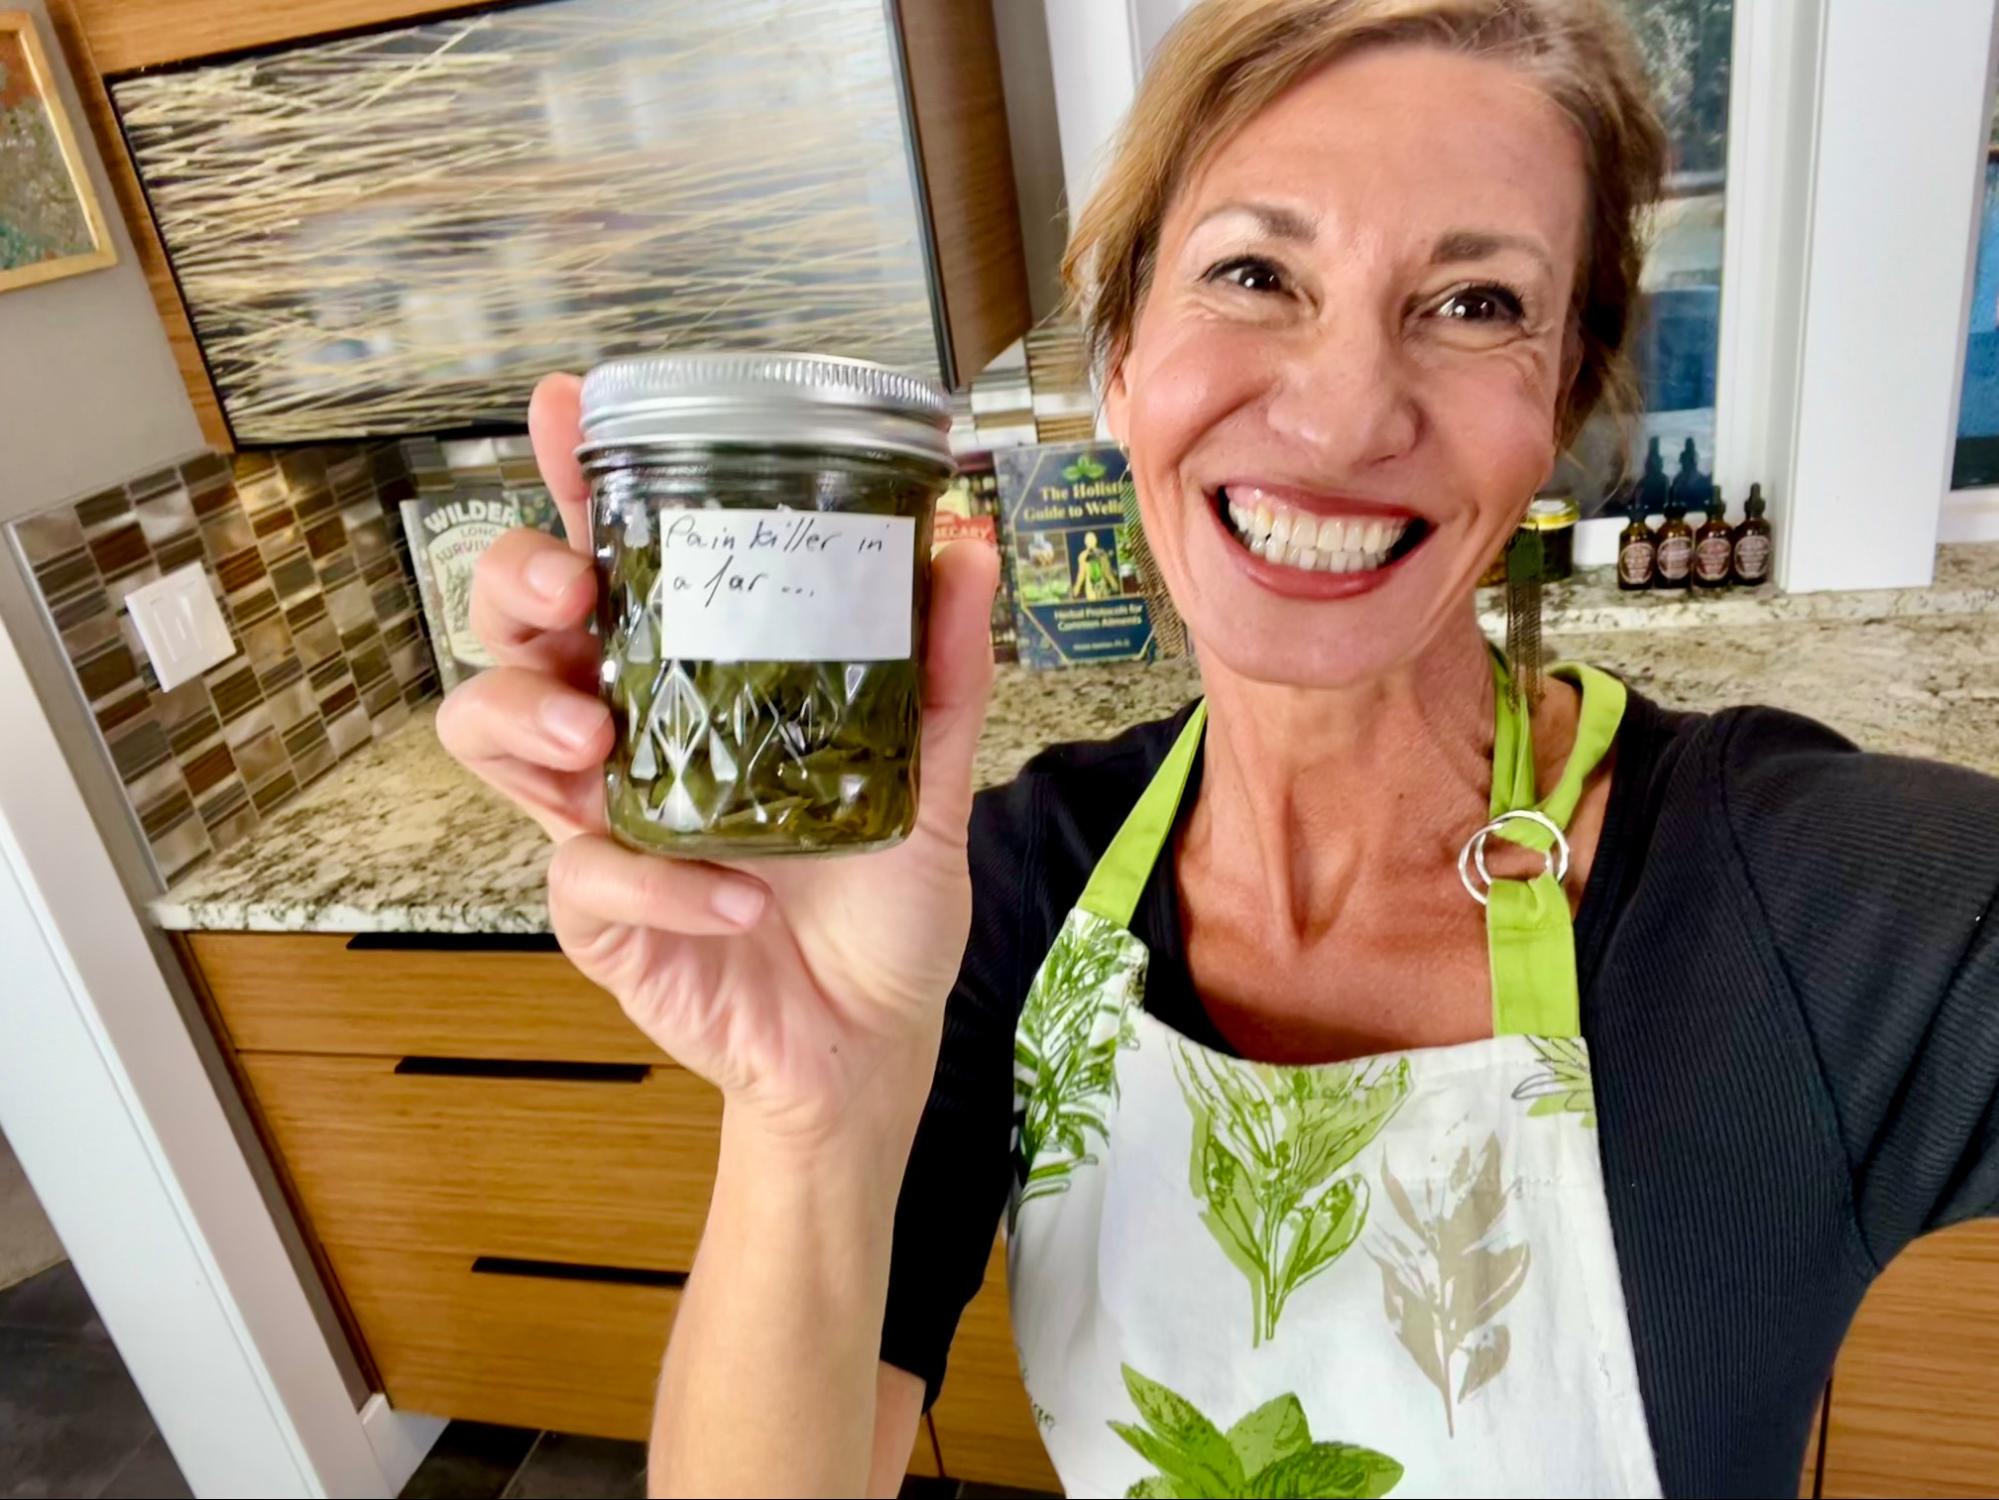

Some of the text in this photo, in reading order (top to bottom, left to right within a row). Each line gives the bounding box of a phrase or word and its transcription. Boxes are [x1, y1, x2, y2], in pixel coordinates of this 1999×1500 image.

[1040, 485, 1069, 502] The
[1023, 505, 1066, 522] Guide
[1068, 505, 1084, 519] to
[666, 514, 735, 550] Pain
[857, 523, 890, 554] in
[673, 575, 693, 591] a
